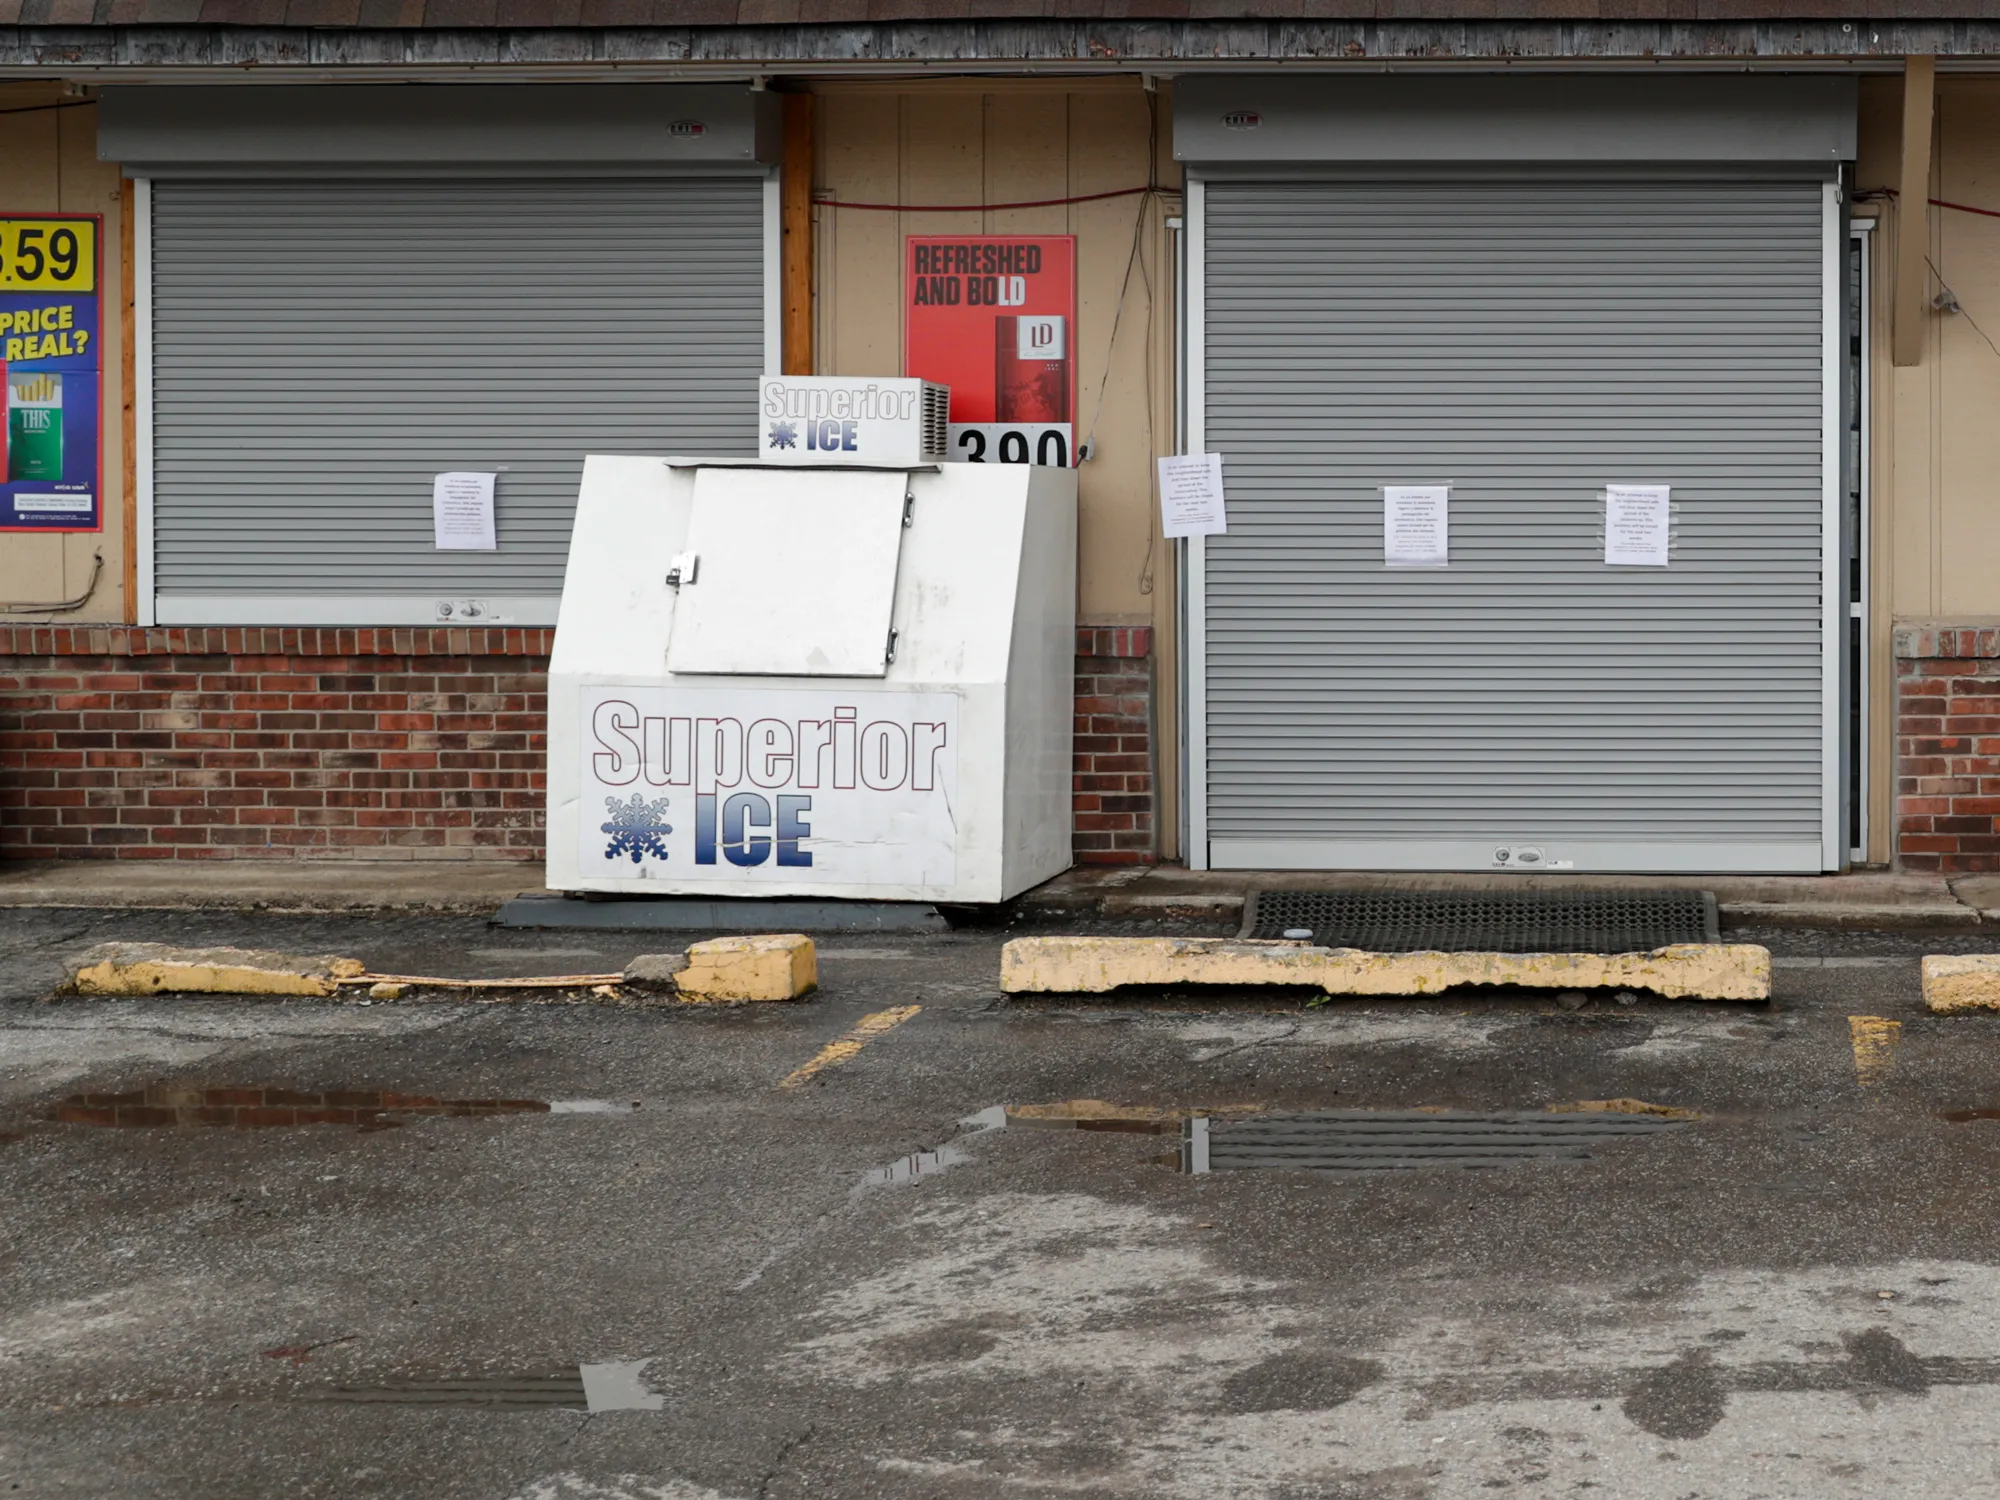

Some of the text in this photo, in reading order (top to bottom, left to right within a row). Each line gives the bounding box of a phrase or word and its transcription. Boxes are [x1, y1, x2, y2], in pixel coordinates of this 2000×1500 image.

[0, 228, 79, 281] .59
[914, 244, 1042, 275] REFRESHED
[913, 276, 1026, 306] AND BOLD
[0, 305, 73, 336] PRICE
[1031, 323, 1053, 348] LD
[6, 329, 90, 362] REAL?
[764, 381, 916, 421] Superior
[20, 409, 51, 429] THIS
[807, 419, 858, 451] ICE
[592, 699, 947, 795] Superior
[694, 791, 813, 868] ICE
